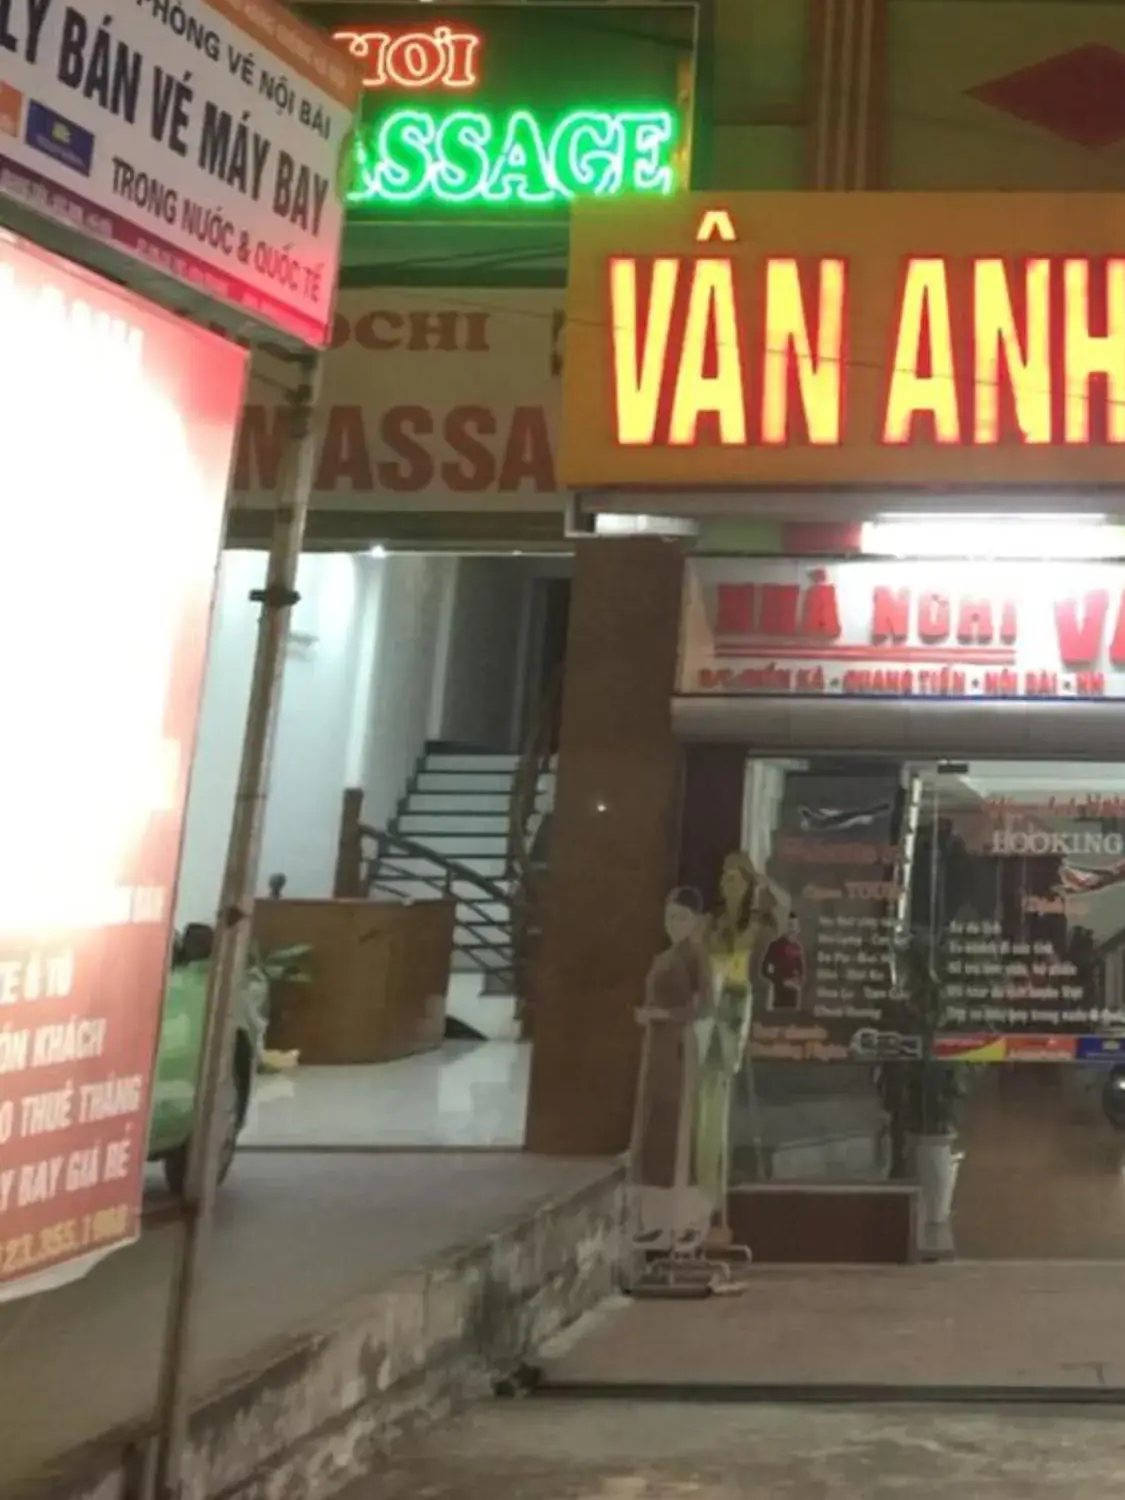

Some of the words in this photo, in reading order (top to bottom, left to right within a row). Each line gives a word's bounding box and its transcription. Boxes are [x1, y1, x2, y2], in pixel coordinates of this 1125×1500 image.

[58, 6, 143, 125] BÁN
[151, 65, 193, 159] VÉ
[199, 100, 271, 203] MÁY
[273, 149, 329, 237] BAY
[112, 155, 178, 226] TRONG
[237, 230, 251, 263] &
[610, 210, 846, 446] VÂN
